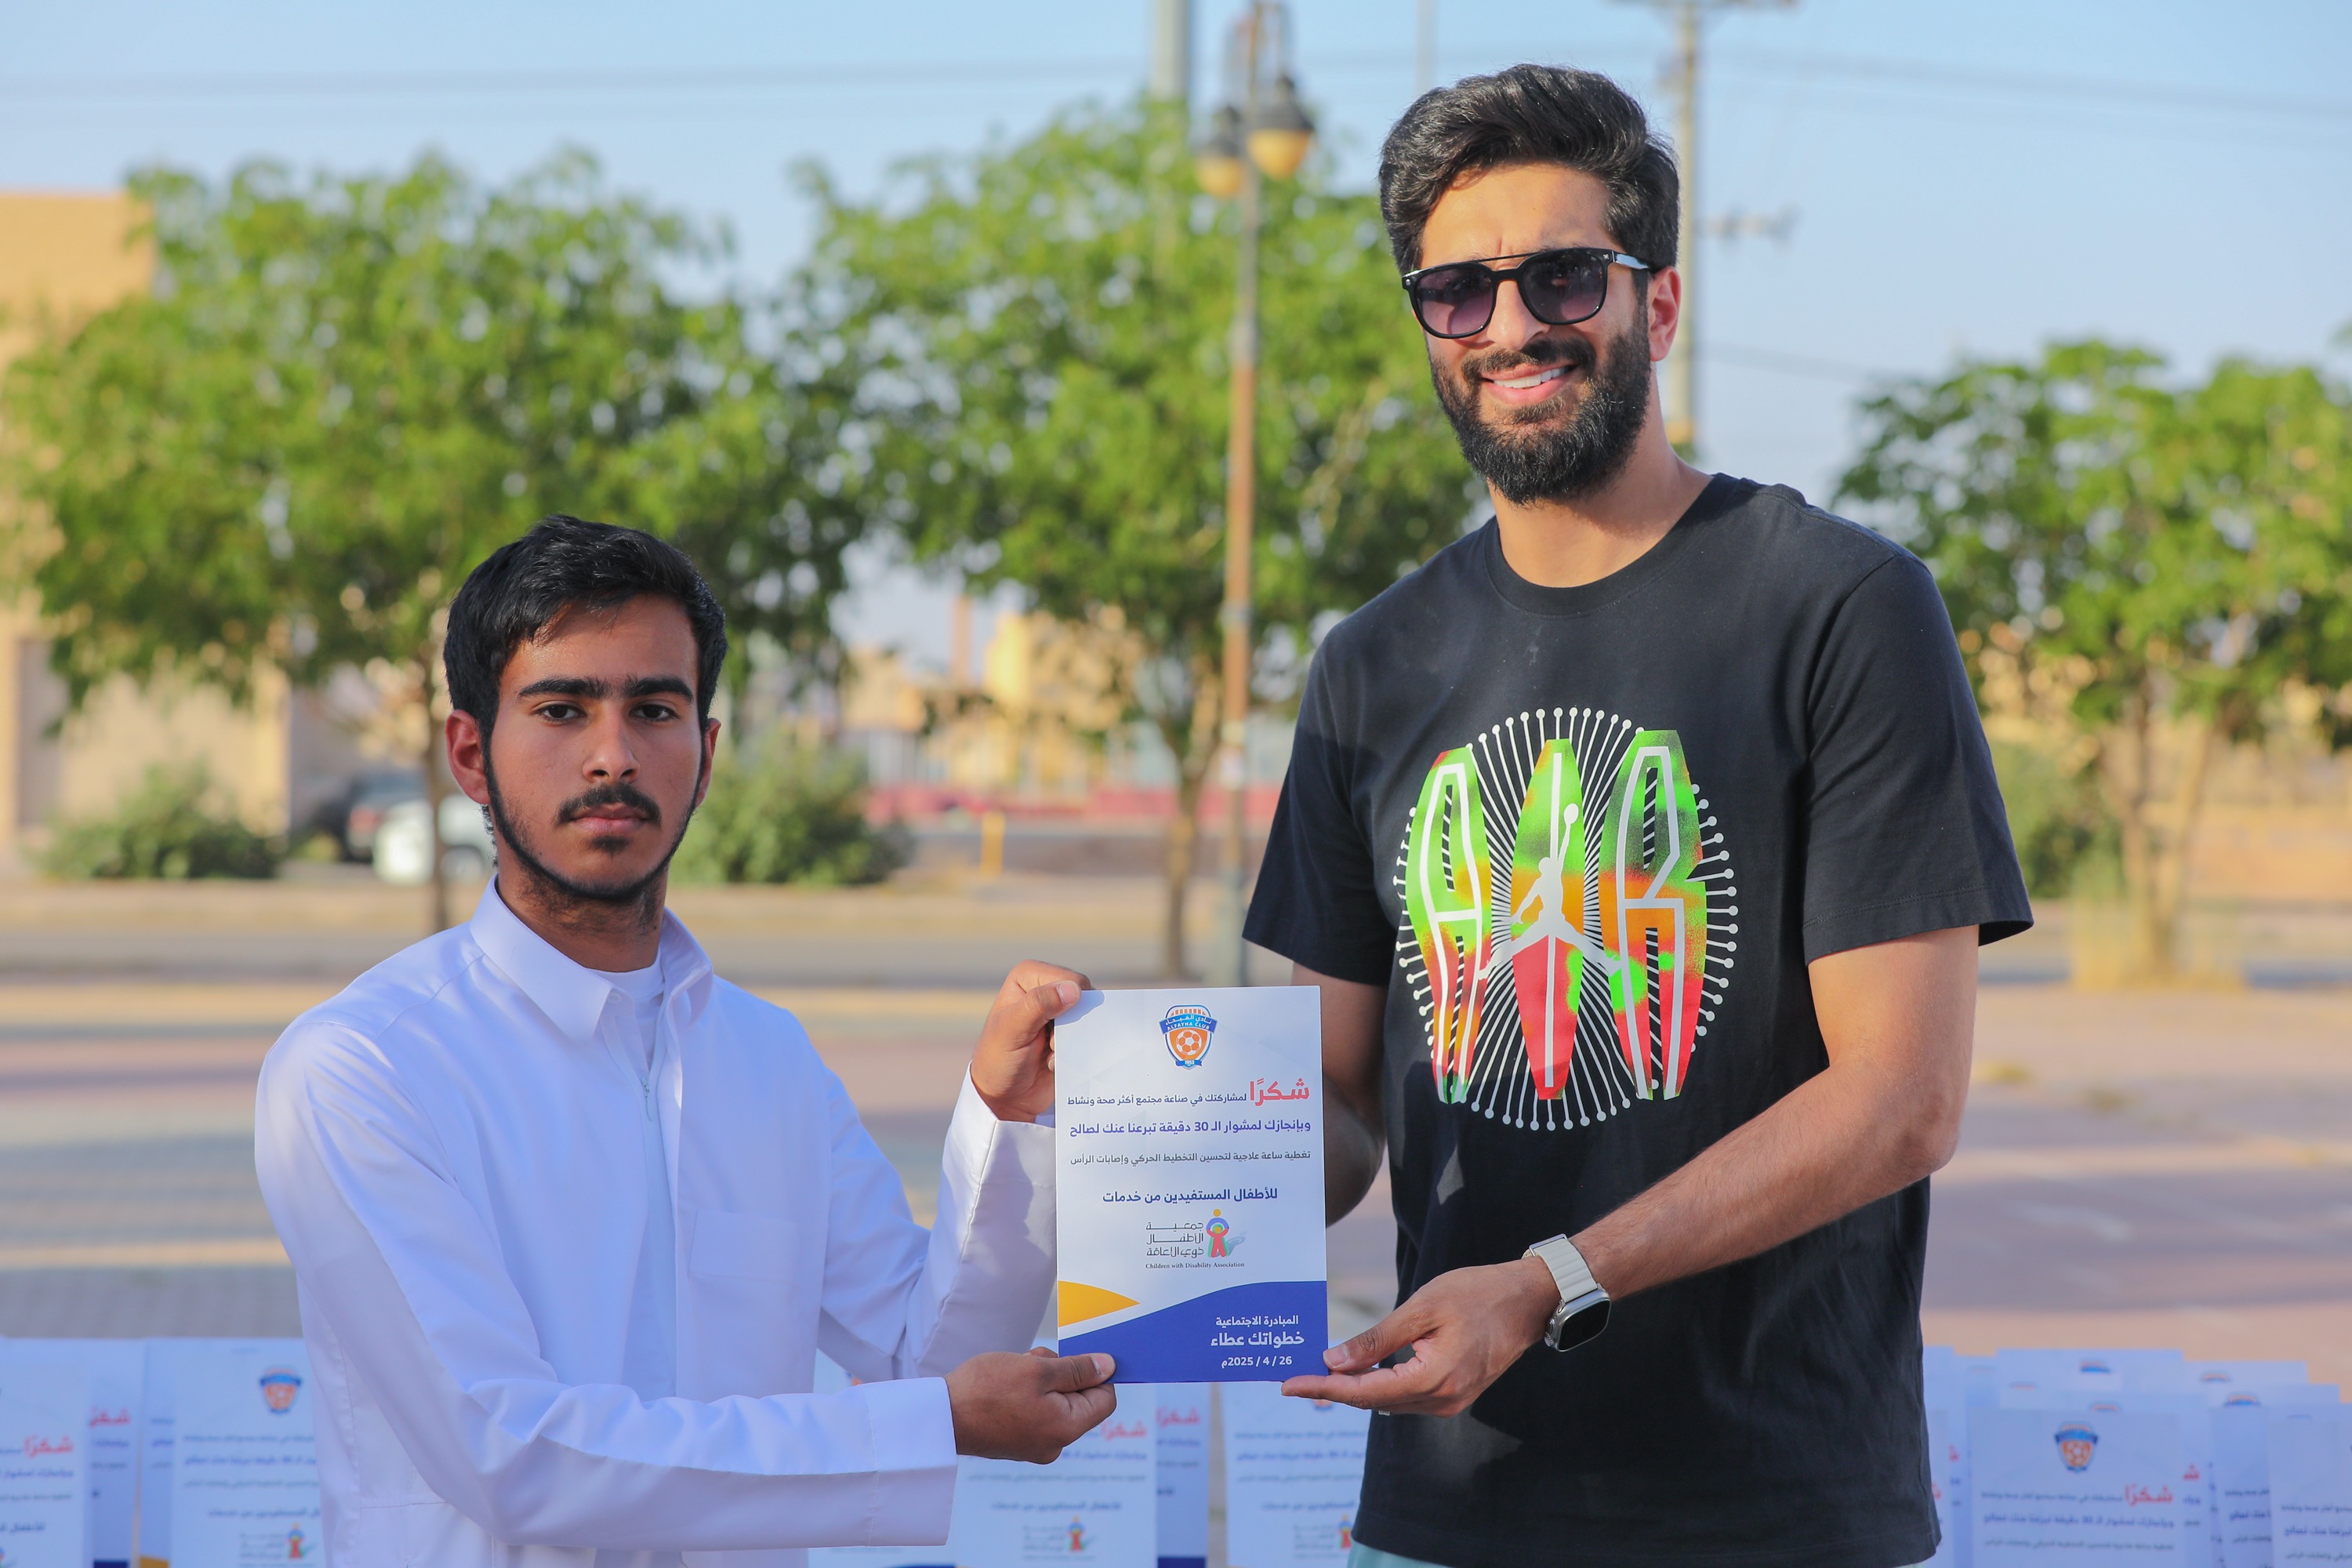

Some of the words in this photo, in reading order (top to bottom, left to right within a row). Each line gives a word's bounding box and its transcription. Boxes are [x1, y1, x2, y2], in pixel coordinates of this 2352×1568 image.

[1167, 1022, 1193, 1031] ALFAYHA
[1250, 1078, 1310, 1106] شكرًا
[1067, 1095, 1095, 1107] ونشاط
[1096, 1096, 1116, 1105] صحة
[1116, 1093, 1134, 1106] أكثر
[1136, 1095, 1162, 1106] مجتمع
[1163, 1094, 1189, 1104] صناعة
[1190, 1094, 1203, 1107] في
[1204, 1093, 1247, 1104] لمشاركتك
[1069, 1123, 1100, 1137] لصالح
[1102, 1122, 1125, 1134] عنك
[1127, 1122, 1157, 1136] تبرعنا
[1159, 1120, 1192, 1135] دقيقة
[1194, 1121, 1209, 1132] 30
[1223, 1119, 1261, 1134] لمشوار
[1264, 1119, 1312, 1134] وبإنجازك
[1070, 1153, 1094, 1166] الرأس
[1096, 1154, 1129, 1166] وإصابات
[1131, 1153, 1161, 1167] الحركي
[1163, 1152, 1198, 1164] التخطيط
[1200, 1152, 1231, 1163] لتحسين
[1232, 1151, 1260, 1162] علاجية
[1261, 1151, 1283, 1160] ساعة
[1284, 1150, 1312, 1161] تغطية
[1102, 1191, 1142, 1203] خدمات
[1144, 1192, 1161, 1204] من
[1163, 1189, 1230, 1204] المستفيدين
[1233, 1186, 1279, 1202] للأطفال
[1185, 1261, 1212, 1270] Disability
[1215, 1316, 1261, 1329] الاجتماعية
[1263, 1314, 1299, 1327] المبادرة
[1210, 1332, 1245, 1346] عطاء
[1247, 1330, 1305, 1348] خطواتك
[1262, 1356, 1270, 1366] 4
[1279, 1356, 1293, 1366] 26
